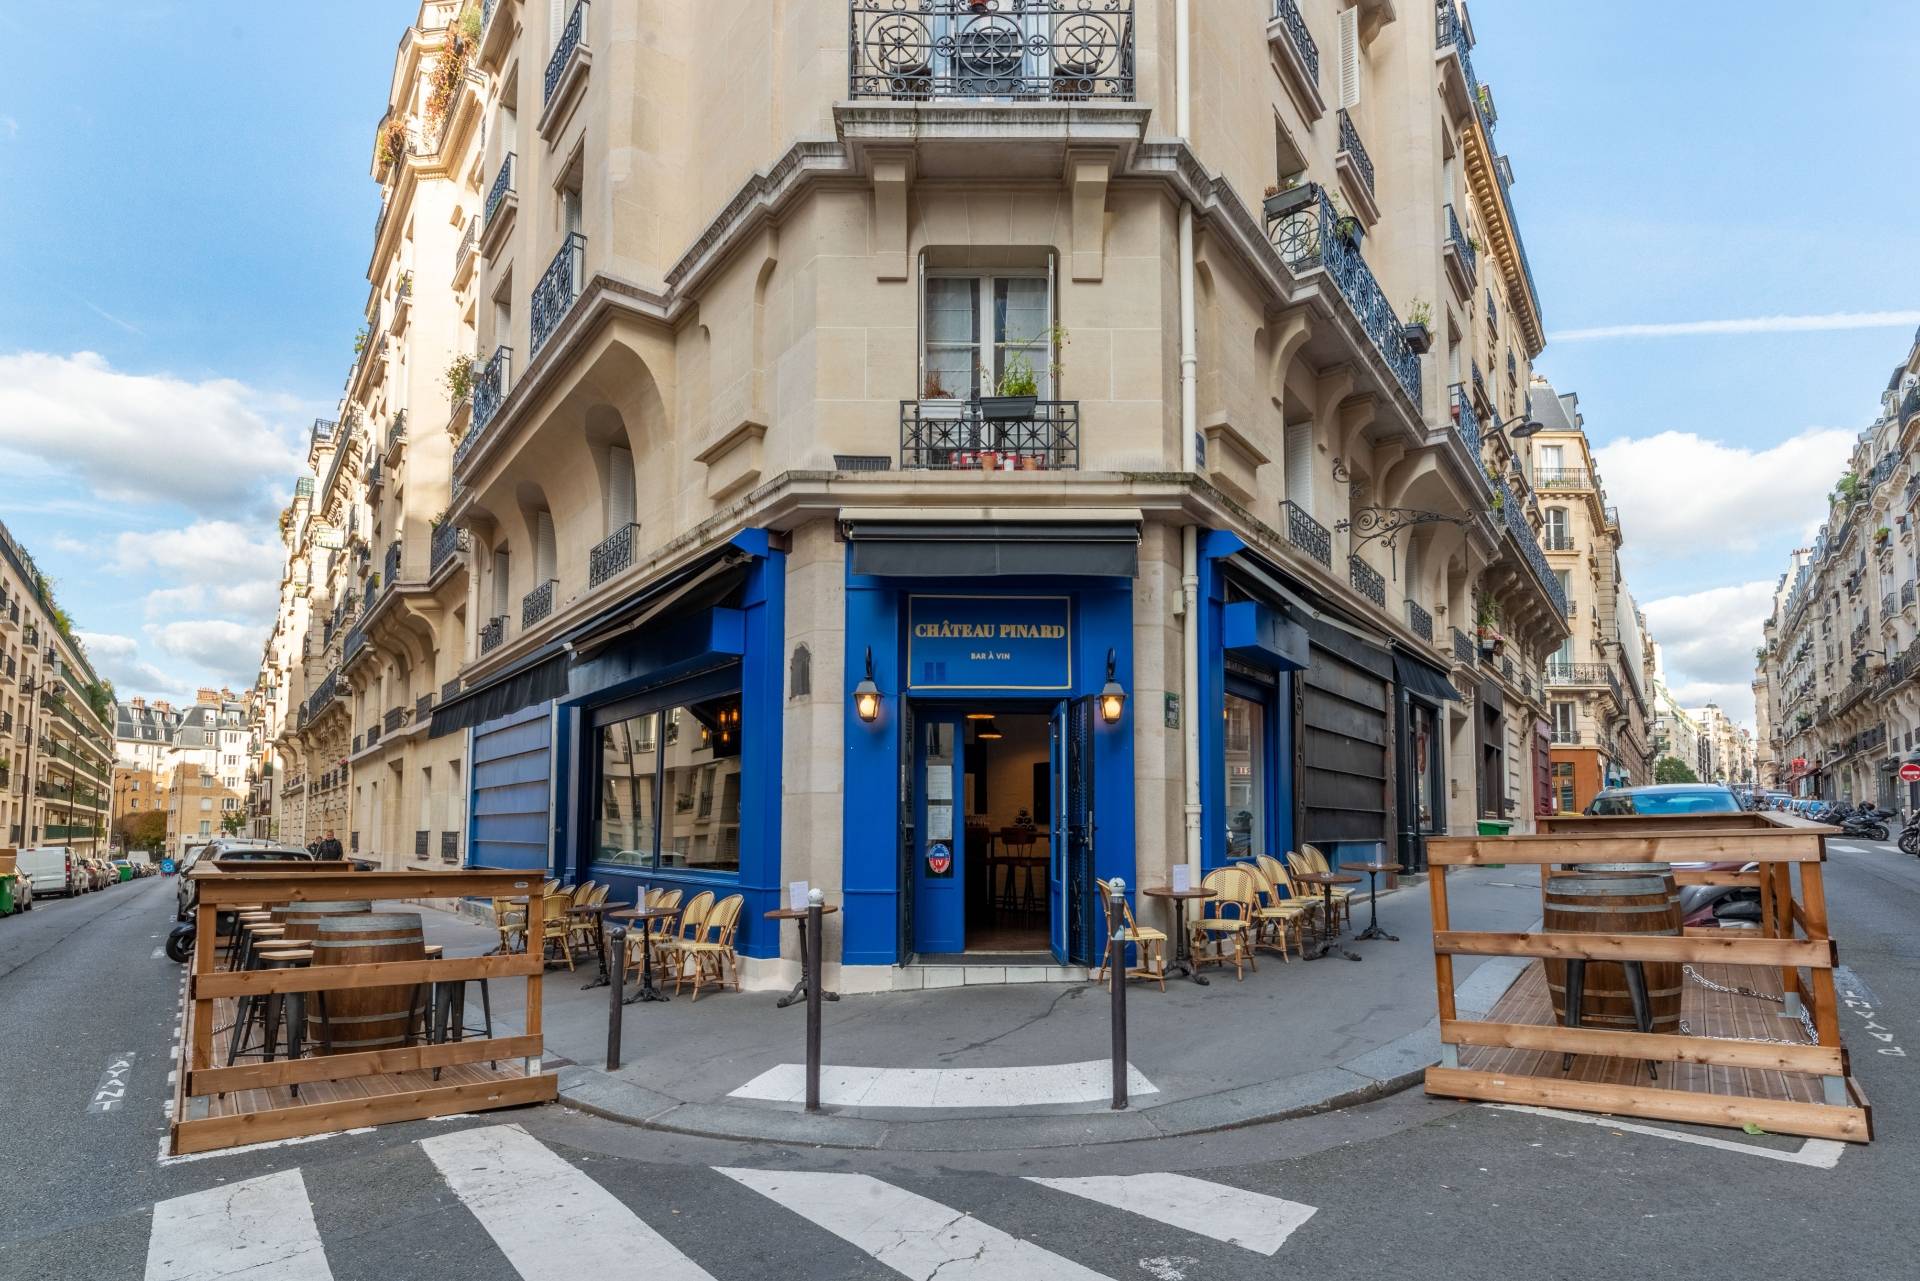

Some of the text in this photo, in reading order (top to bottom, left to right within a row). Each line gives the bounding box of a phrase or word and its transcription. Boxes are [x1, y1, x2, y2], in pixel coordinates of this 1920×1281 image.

[914, 619, 1065, 638] CHÂTEAU PINARD
[970, 650, 1010, 660] BAR À VIN
[1844, 990, 1906, 1056] PAYANT
[94, 1051, 136, 1111] AYANT
